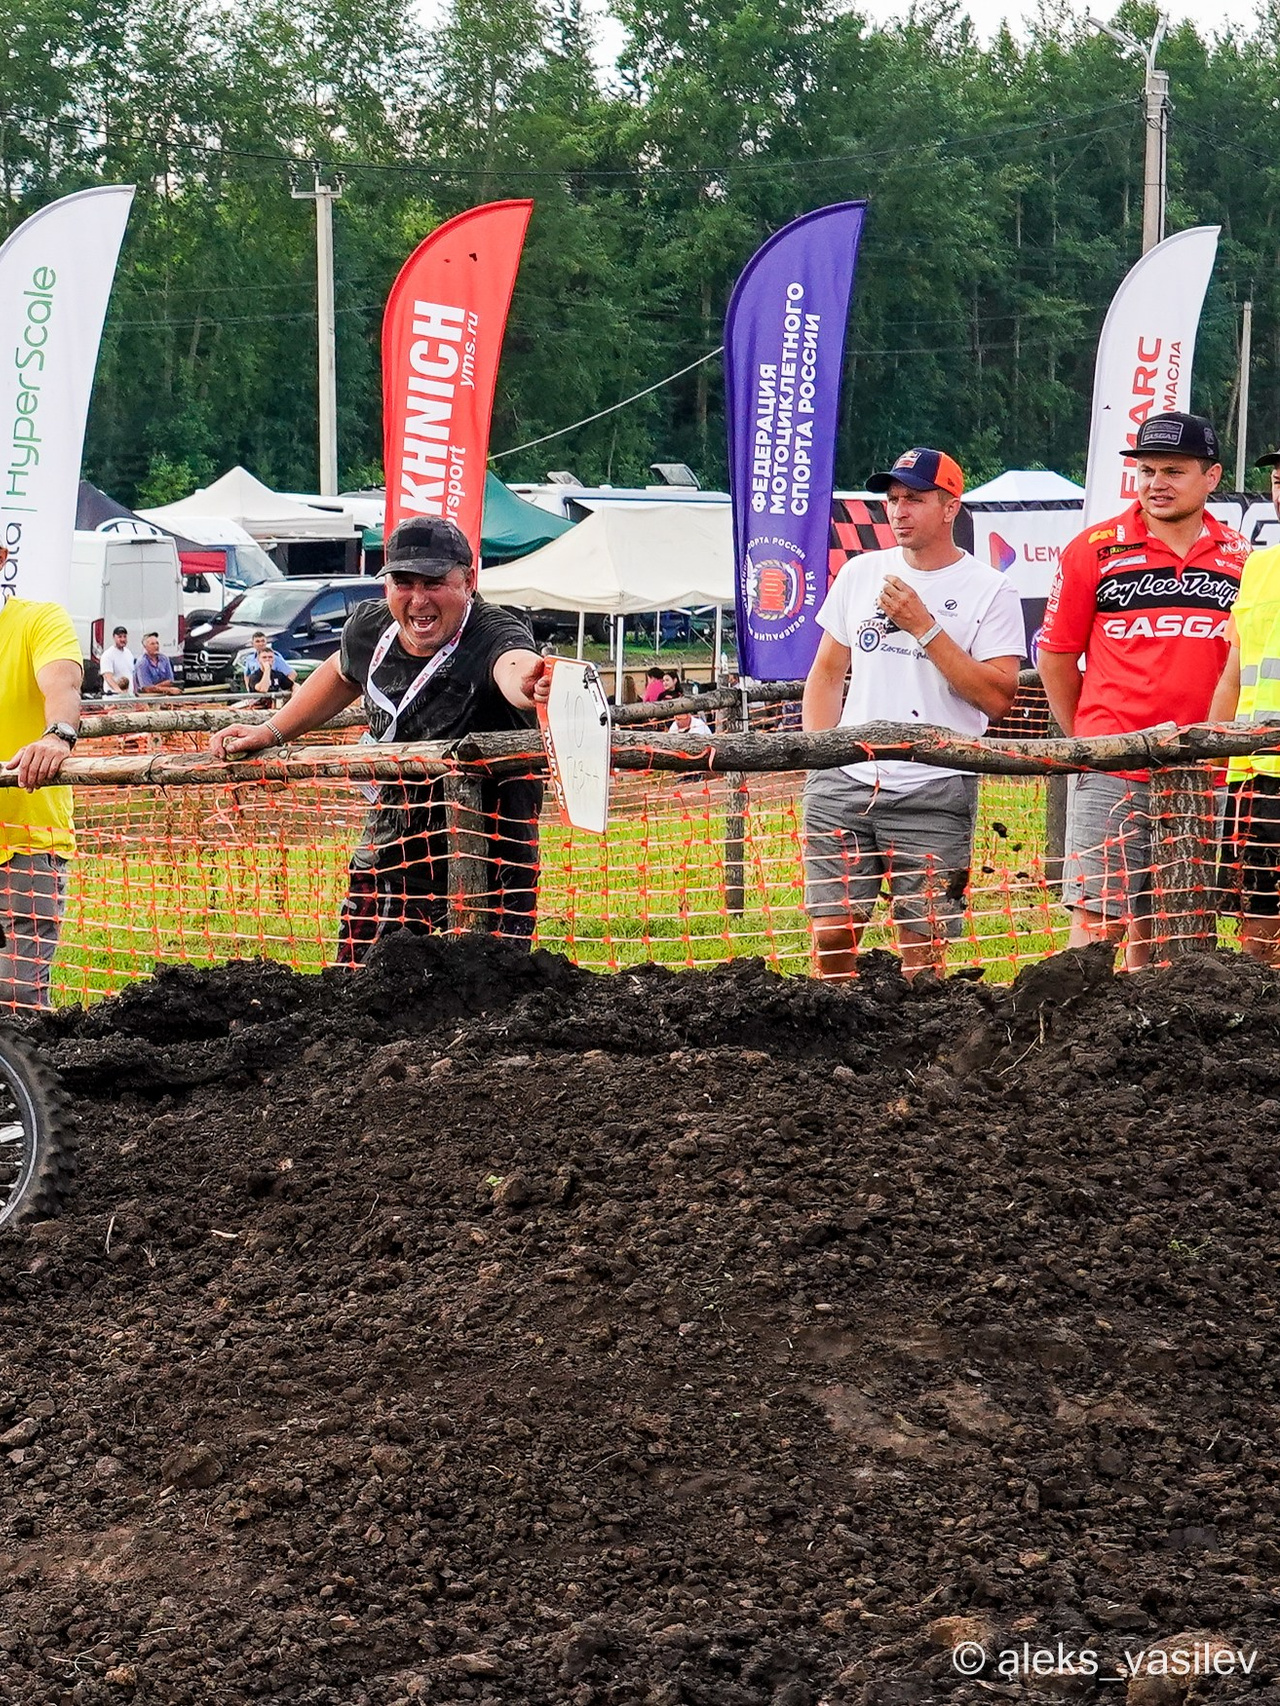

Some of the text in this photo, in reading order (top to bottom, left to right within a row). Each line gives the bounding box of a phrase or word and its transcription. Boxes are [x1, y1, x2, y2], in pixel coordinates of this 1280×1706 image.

[6, 266, 57, 497] HyperScale
[460, 311, 479, 390] yms.ru
[1163, 341, 1182, 412] МАСЛА
[399, 300, 466, 518] KHNICH
[751, 363, 777, 513] ФЕДЕРАЦИЯ
[770, 282, 805, 515] МОТОЦИКЛЕТНОГО
[790, 313, 821, 516] СПОРТА РОССИИ
[804, 570, 817, 607] MFR
[1023, 543, 1060, 562] LEM
[1136, 573, 1181, 596] Lee
[1103, 615, 1230, 640] GASGA
